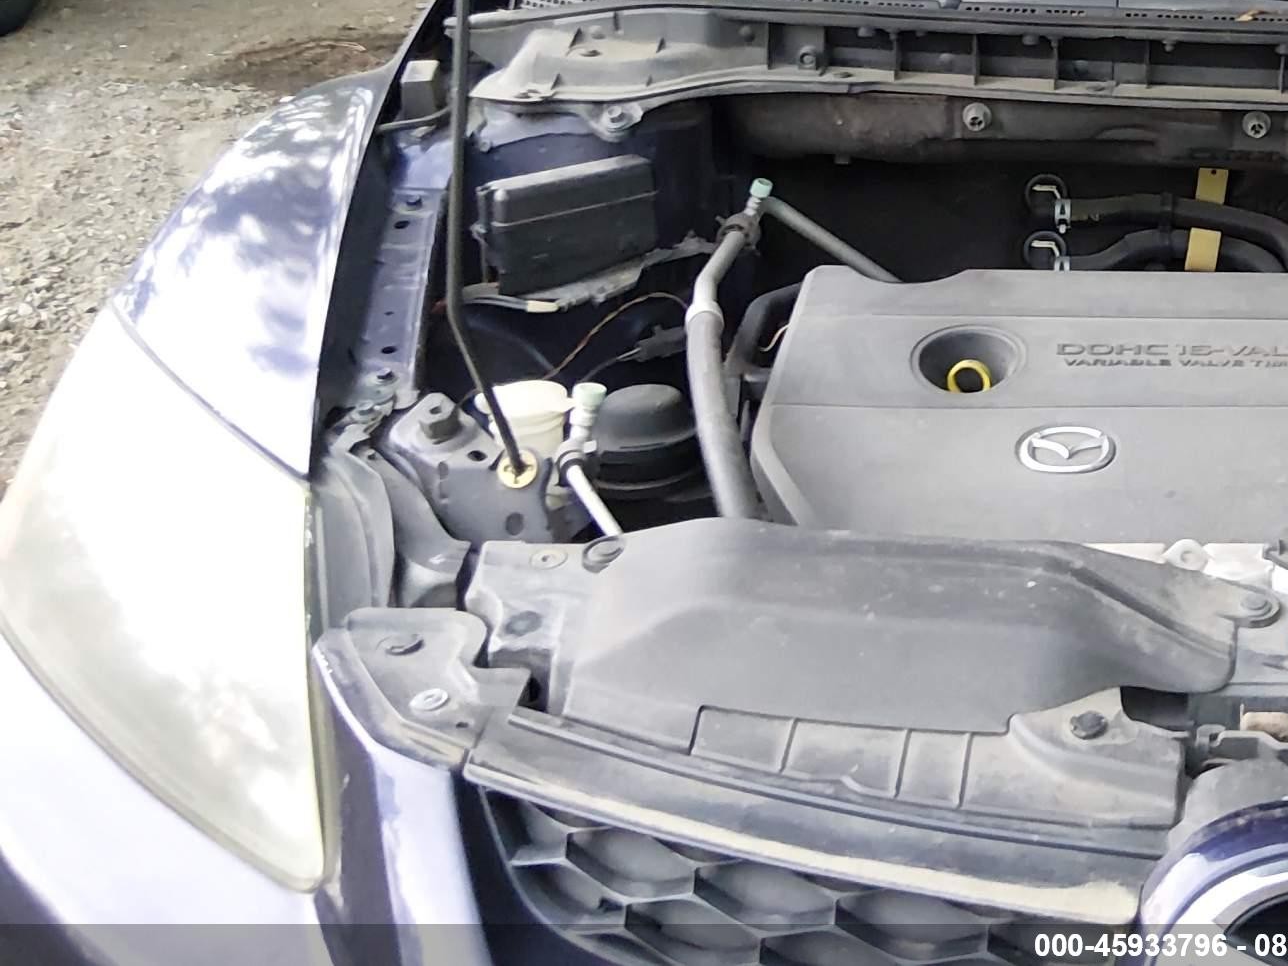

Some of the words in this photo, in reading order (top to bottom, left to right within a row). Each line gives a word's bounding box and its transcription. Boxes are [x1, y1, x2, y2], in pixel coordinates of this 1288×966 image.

[1056, 343, 1169, 356] DOHC
[1063, 358, 1172, 367] VARIABLE
[1178, 358, 1246, 368] VALVE
